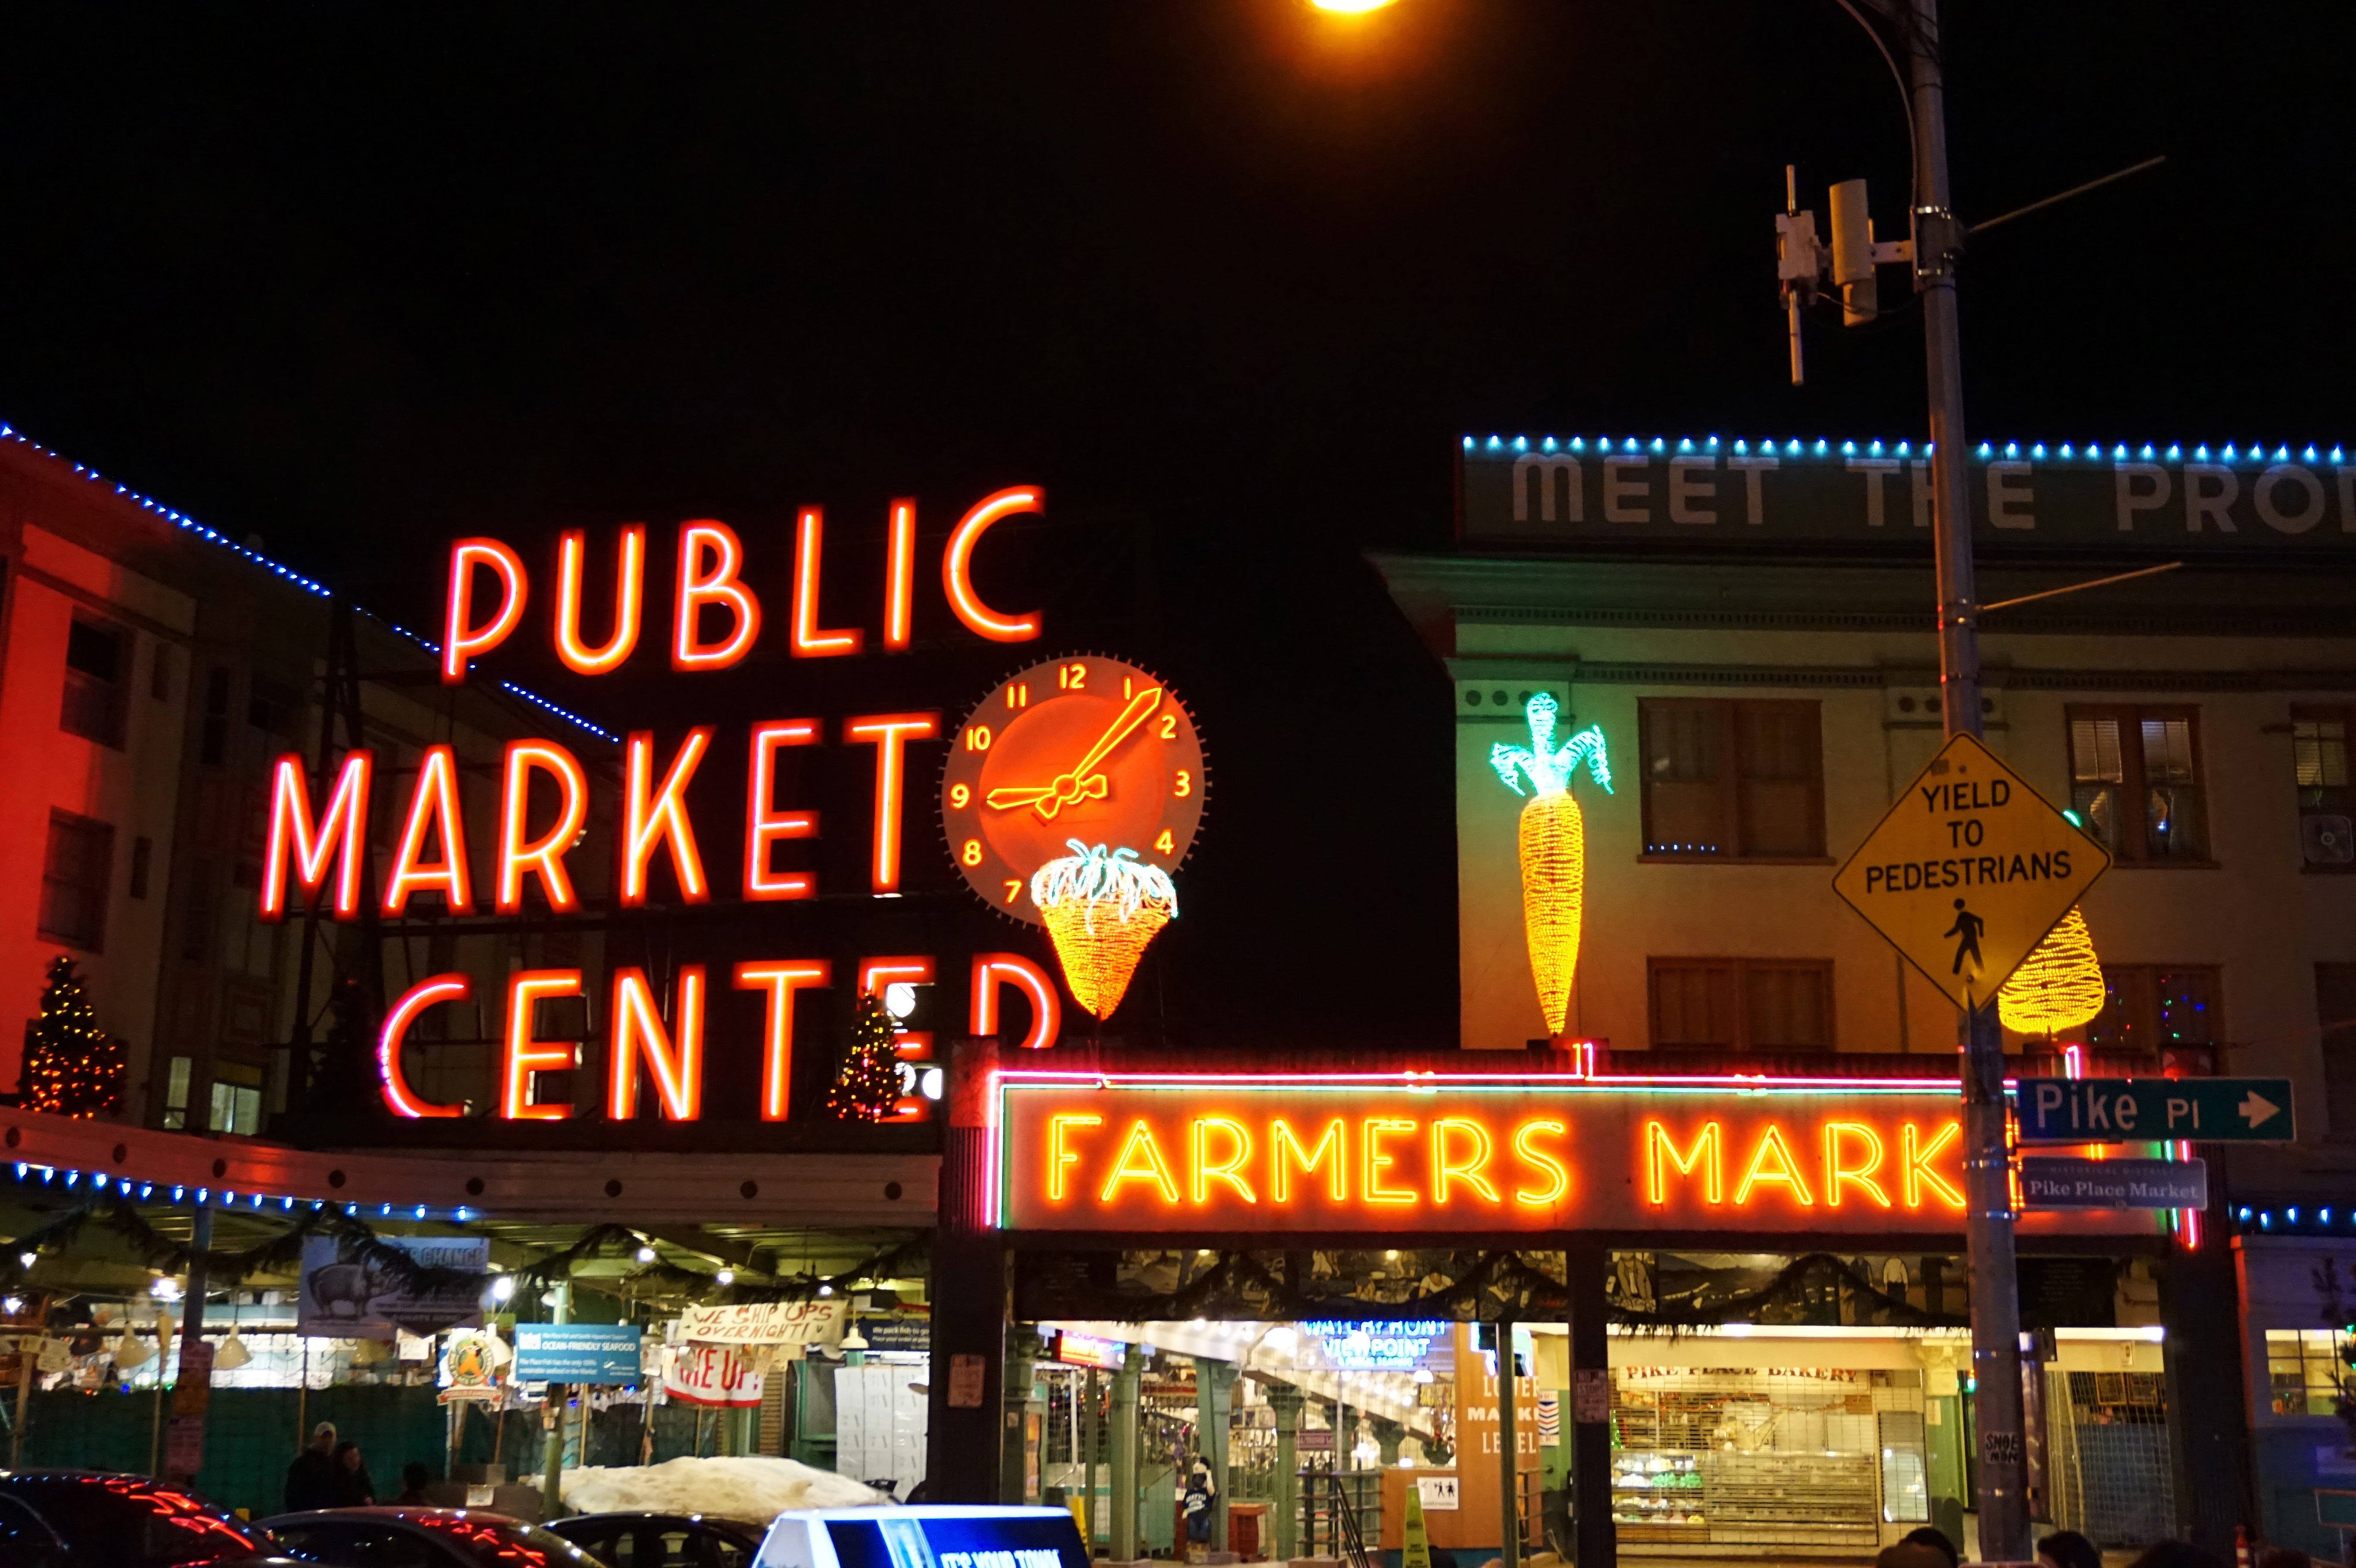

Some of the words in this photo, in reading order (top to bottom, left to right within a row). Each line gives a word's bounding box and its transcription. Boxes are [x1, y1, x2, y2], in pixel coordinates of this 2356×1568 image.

[1513, 451, 1779, 524] MEET
[446, 486, 1042, 682] PUBLIC
[1060, 664, 1086, 689] 12
[1124, 677, 1131, 700] 1
[1007, 684, 1027, 708] 11
[966, 726, 990, 751] 10
[1161, 716, 1176, 739] 2
[951, 784, 969, 808] 9
[1175, 771, 1190, 797] 3
[1921, 779, 2011, 813] YIELD
[263, 714, 939, 919] MARKET
[1155, 829, 1173, 854] 4
[1947, 819, 1983, 847] TO
[963, 840, 981, 865] 8
[1866, 850, 2071, 893] PEDESTRIANS
[1004, 880, 1022, 903] 7
[2036, 1084, 2138, 1130] Pike
[2166, 1098, 2200, 1129] Pl
[1048, 1116, 1569, 1205] FARMERS
[1649, 1120, 2025, 1208] MARK
[2030, 1180, 2071, 1195] Pike
[2075, 1181, 2125, 1196] Place
[2130, 1182, 2197, 1198] Market
[694, 1310, 726, 1324] WE
[733, 1306, 778, 1324] SHIP
[786, 1305, 833, 1321] UPS
[1468, 1407, 1539, 1421] MAK
[1483, 1432, 1536, 1454] LEEL
